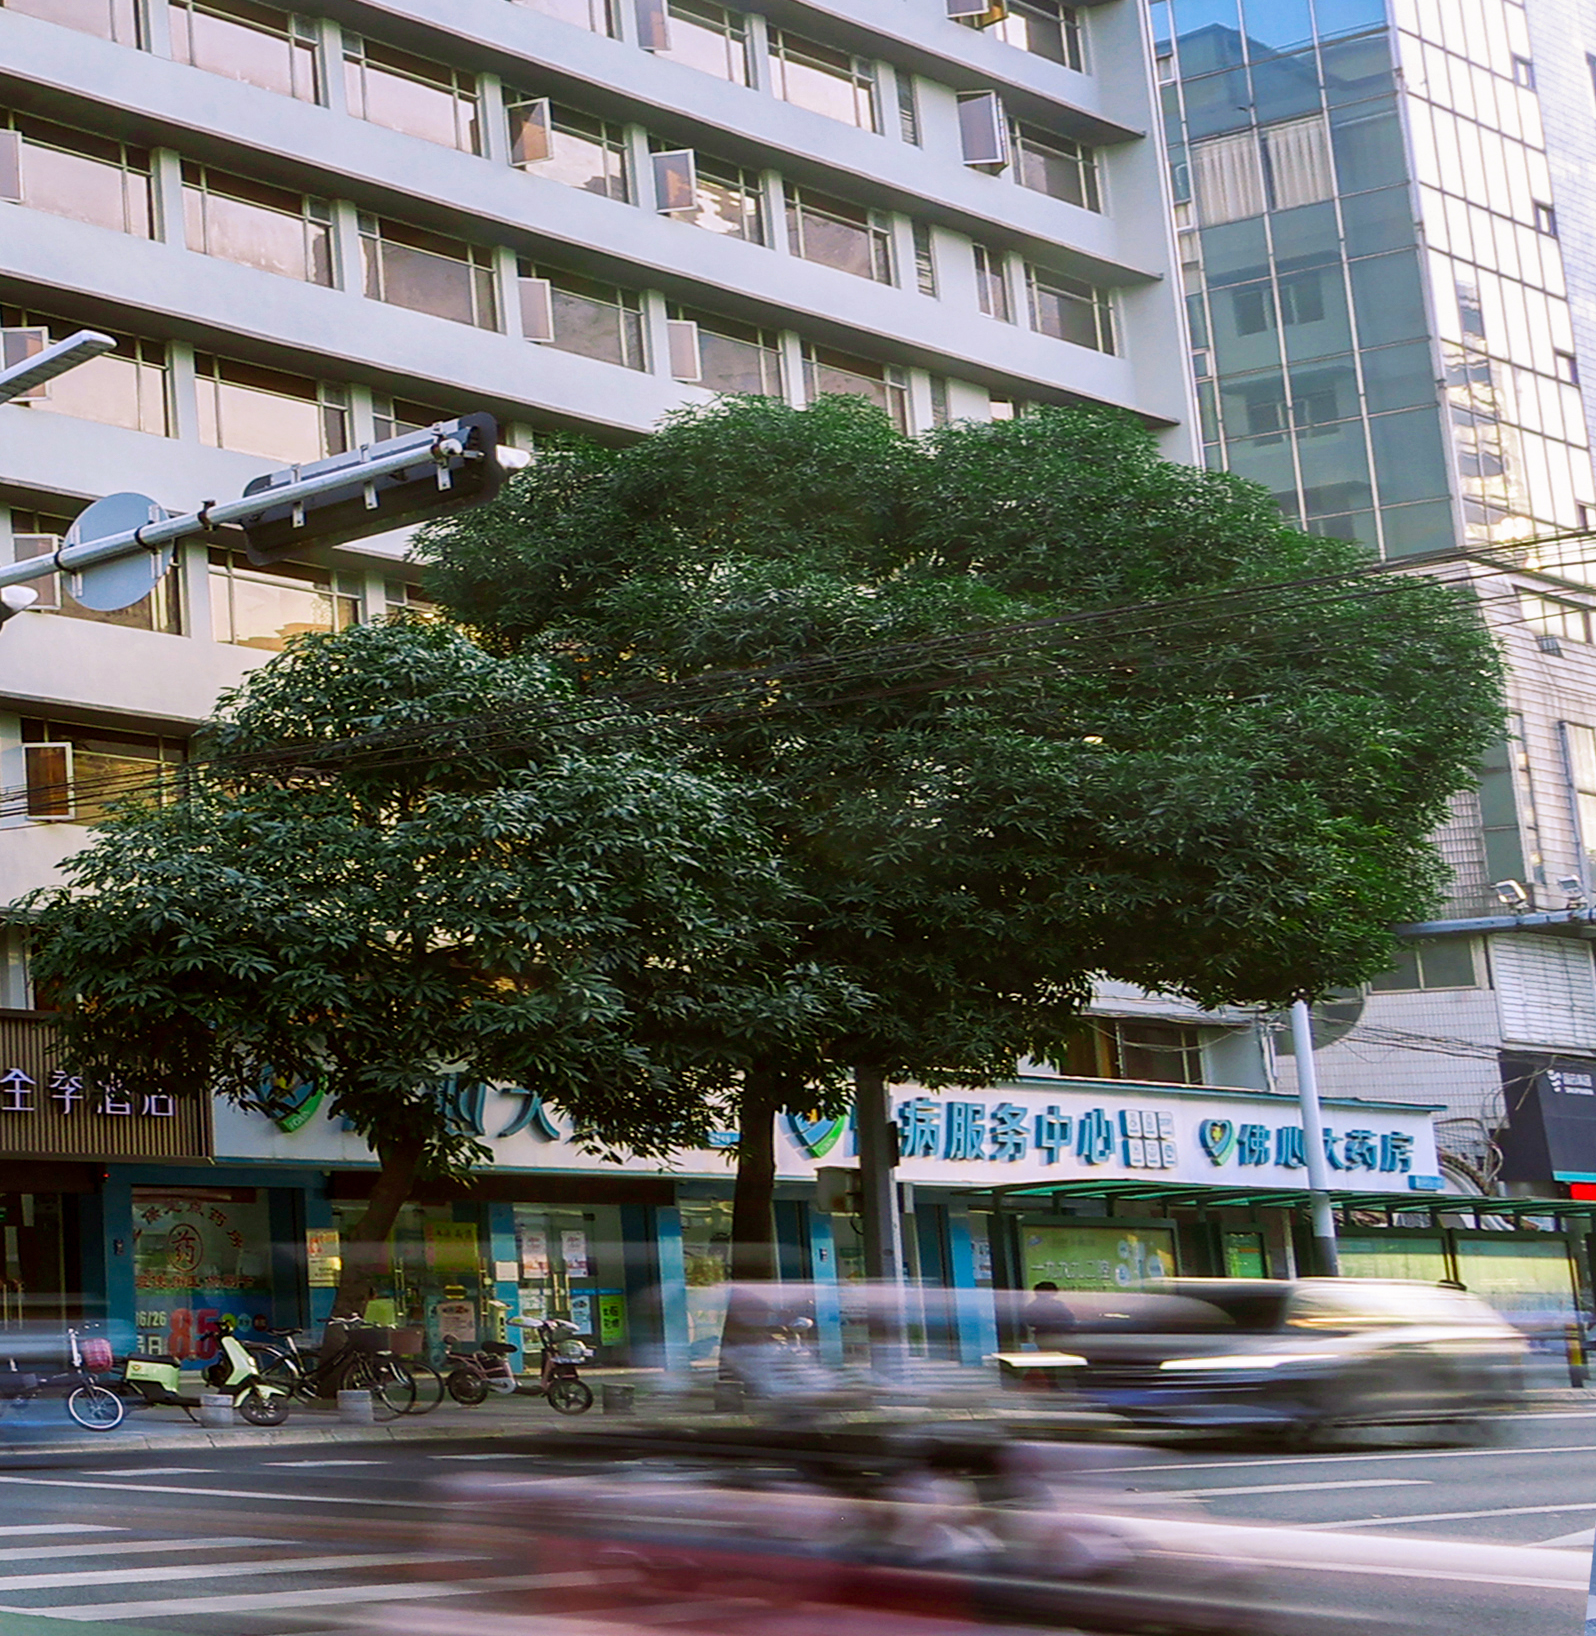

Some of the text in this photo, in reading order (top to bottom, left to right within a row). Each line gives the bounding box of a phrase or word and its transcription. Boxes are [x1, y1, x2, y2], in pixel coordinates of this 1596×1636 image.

[850, 1096, 1116, 1165] 病服务中心
